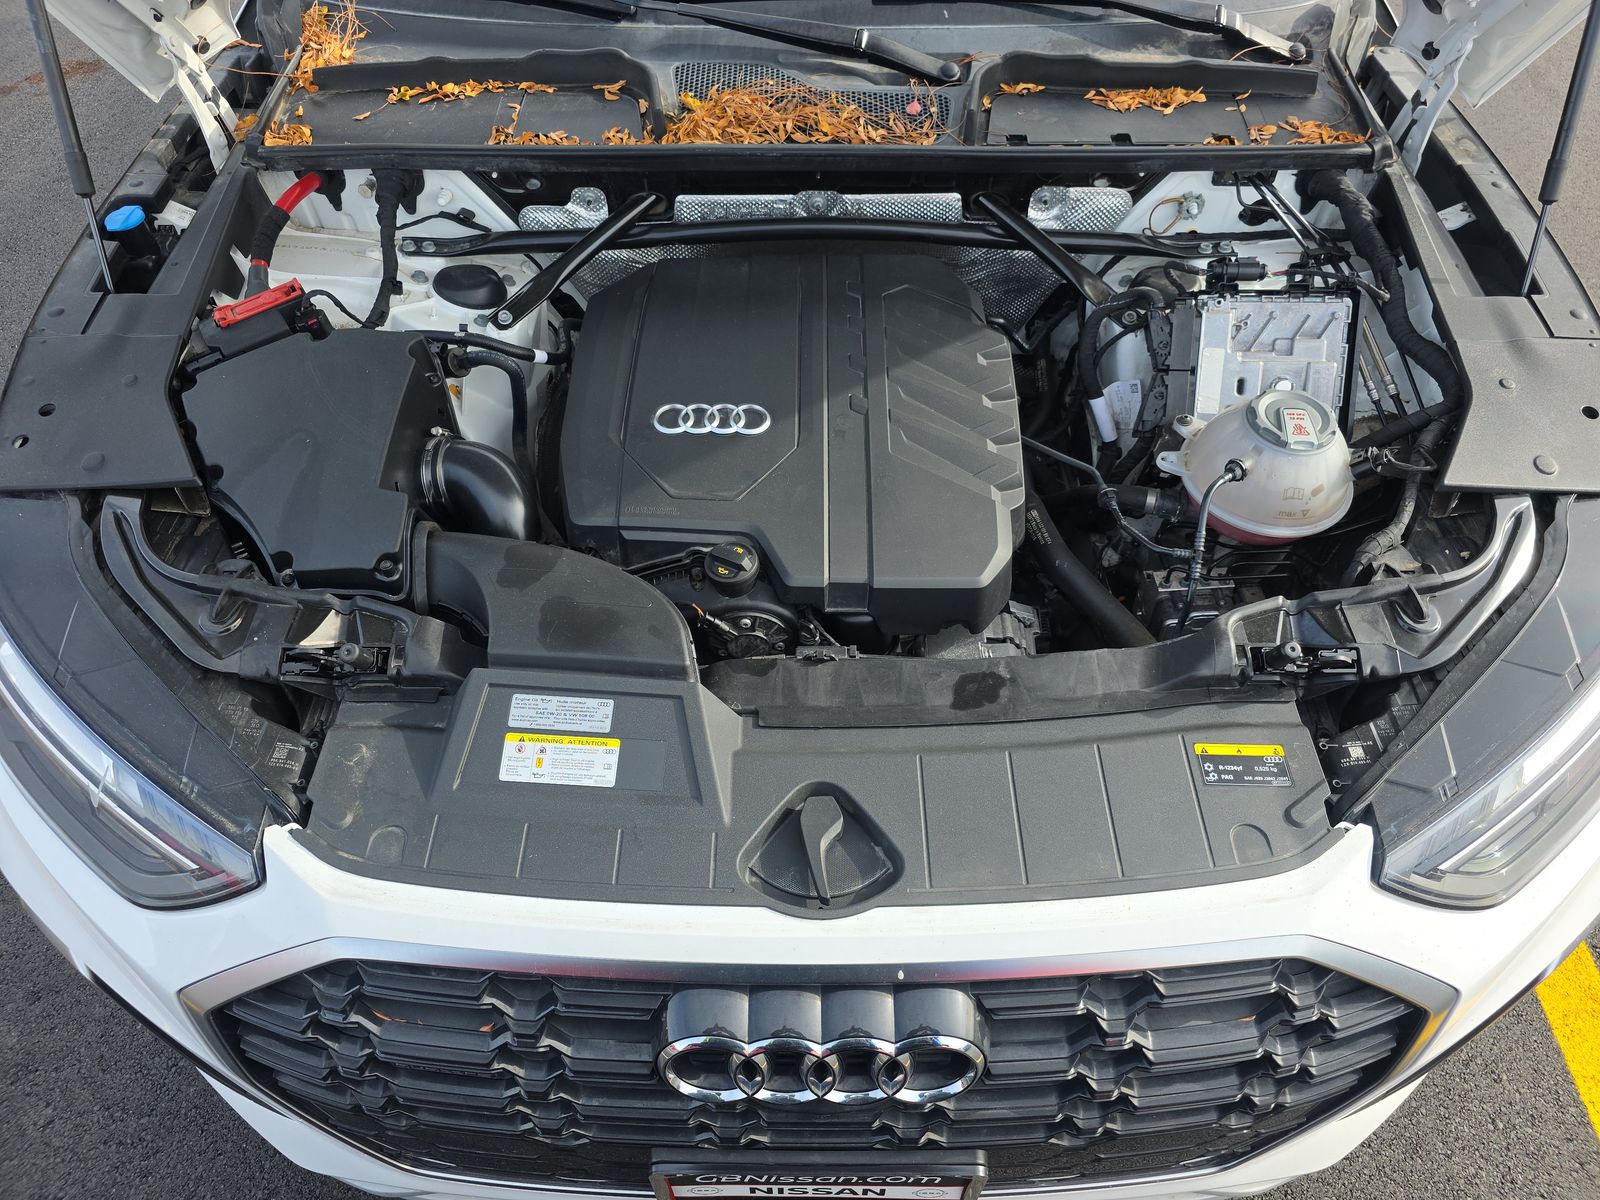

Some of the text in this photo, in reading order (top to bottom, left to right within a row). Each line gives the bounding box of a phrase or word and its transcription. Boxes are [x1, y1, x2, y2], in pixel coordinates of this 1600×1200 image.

[528, 737, 608, 747] WARNING ATTENTION
[695, 1174, 942, 1184] GBNissan.com
[750, 1187, 886, 1196] NISSAN
